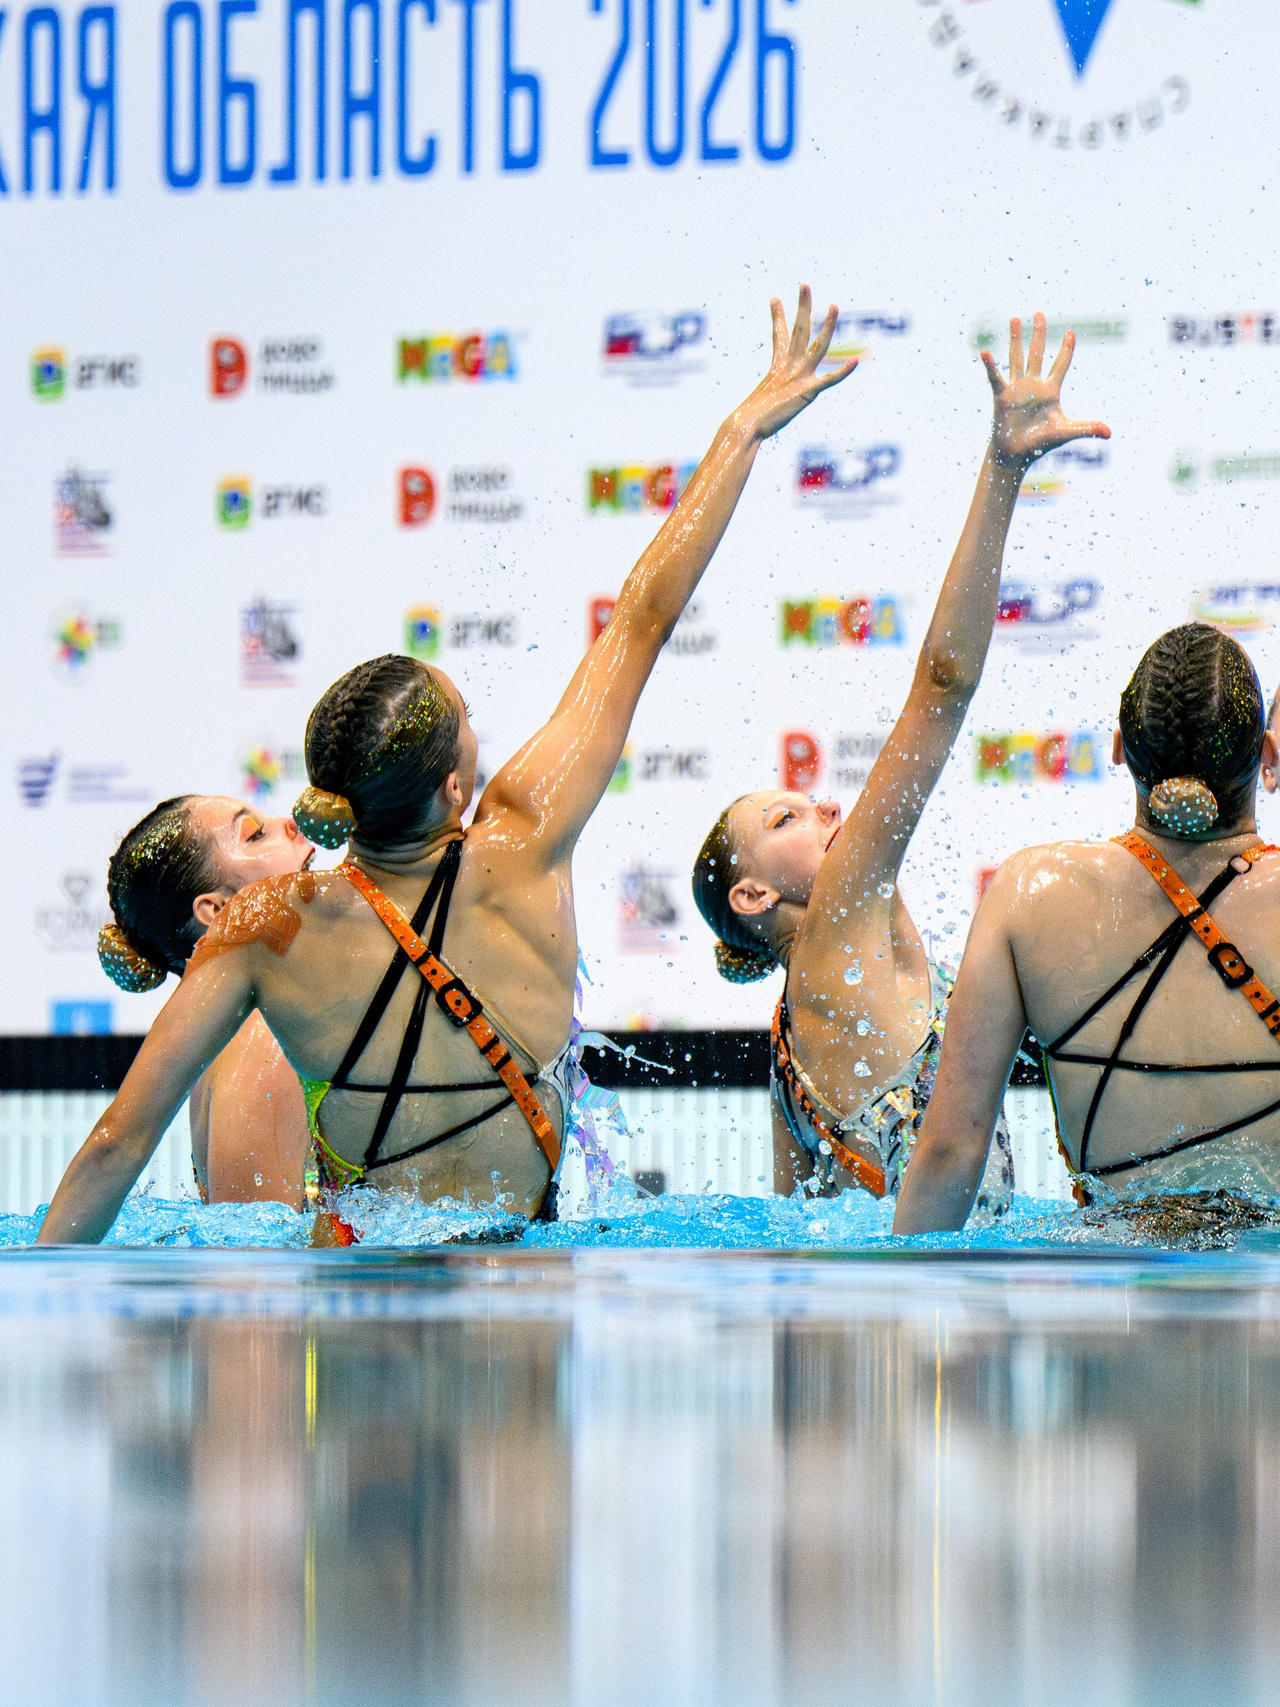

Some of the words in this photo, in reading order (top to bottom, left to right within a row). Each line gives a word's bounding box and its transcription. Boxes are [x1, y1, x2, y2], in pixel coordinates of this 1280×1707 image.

[0, 5, 119, 198] АЯ
[162, 0, 543, 189] ОБЛАСТЬ
[588, 0, 798, 167] 2026
